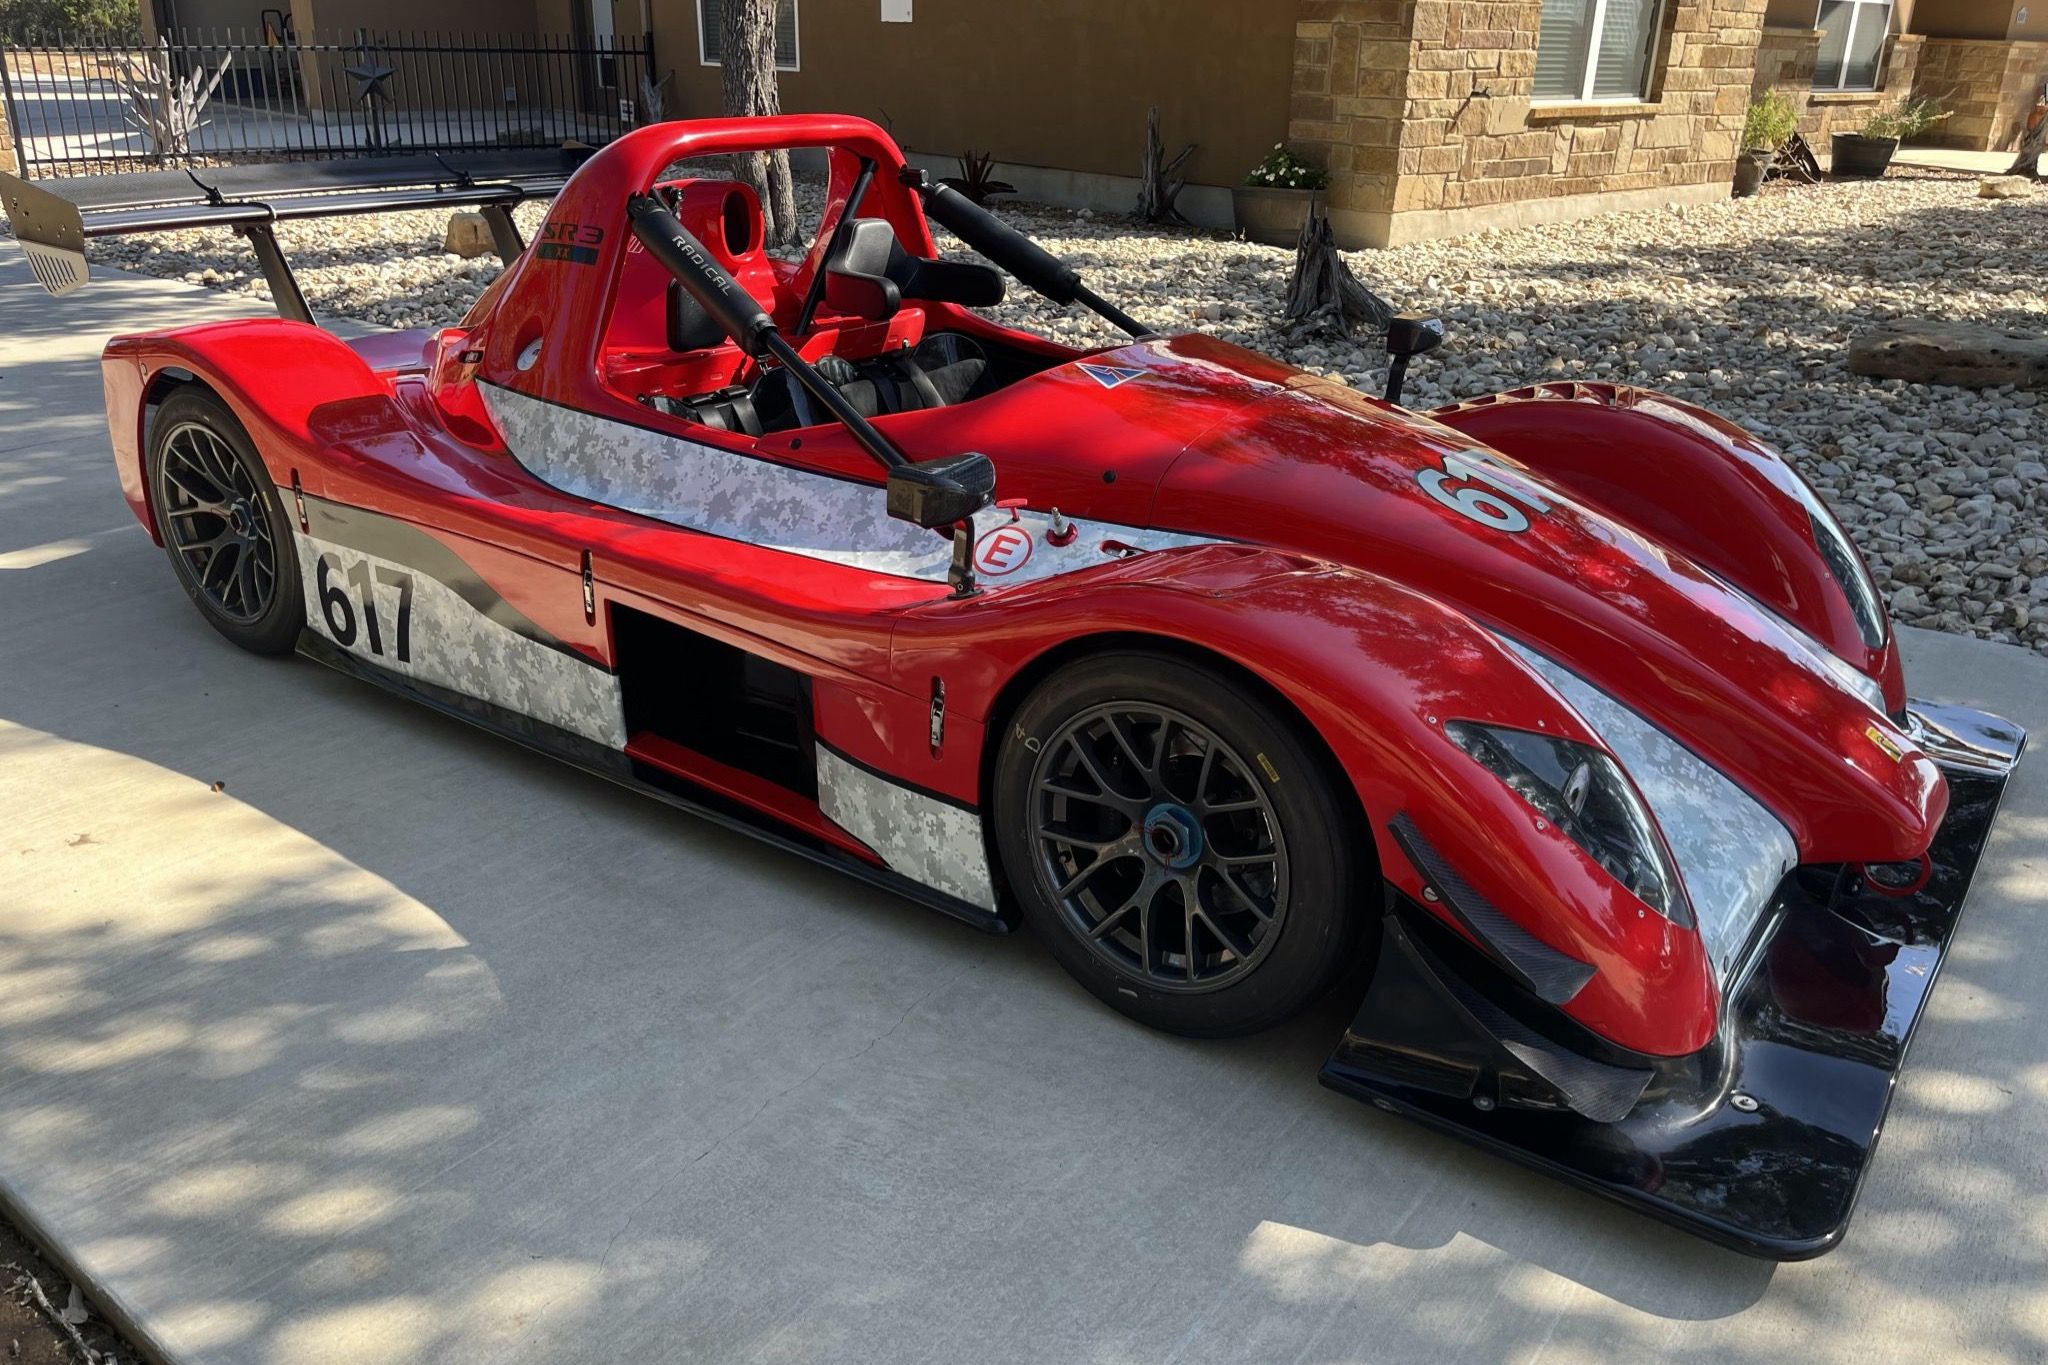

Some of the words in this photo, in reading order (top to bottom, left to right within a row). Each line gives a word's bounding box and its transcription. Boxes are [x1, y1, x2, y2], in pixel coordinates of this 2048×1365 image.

[540, 222, 604, 245] SR3
[671, 235, 733, 297] RADICAL
[982, 534, 1023, 568] E
[316, 551, 414, 664] 617
[1024, 736, 1041, 754] D
